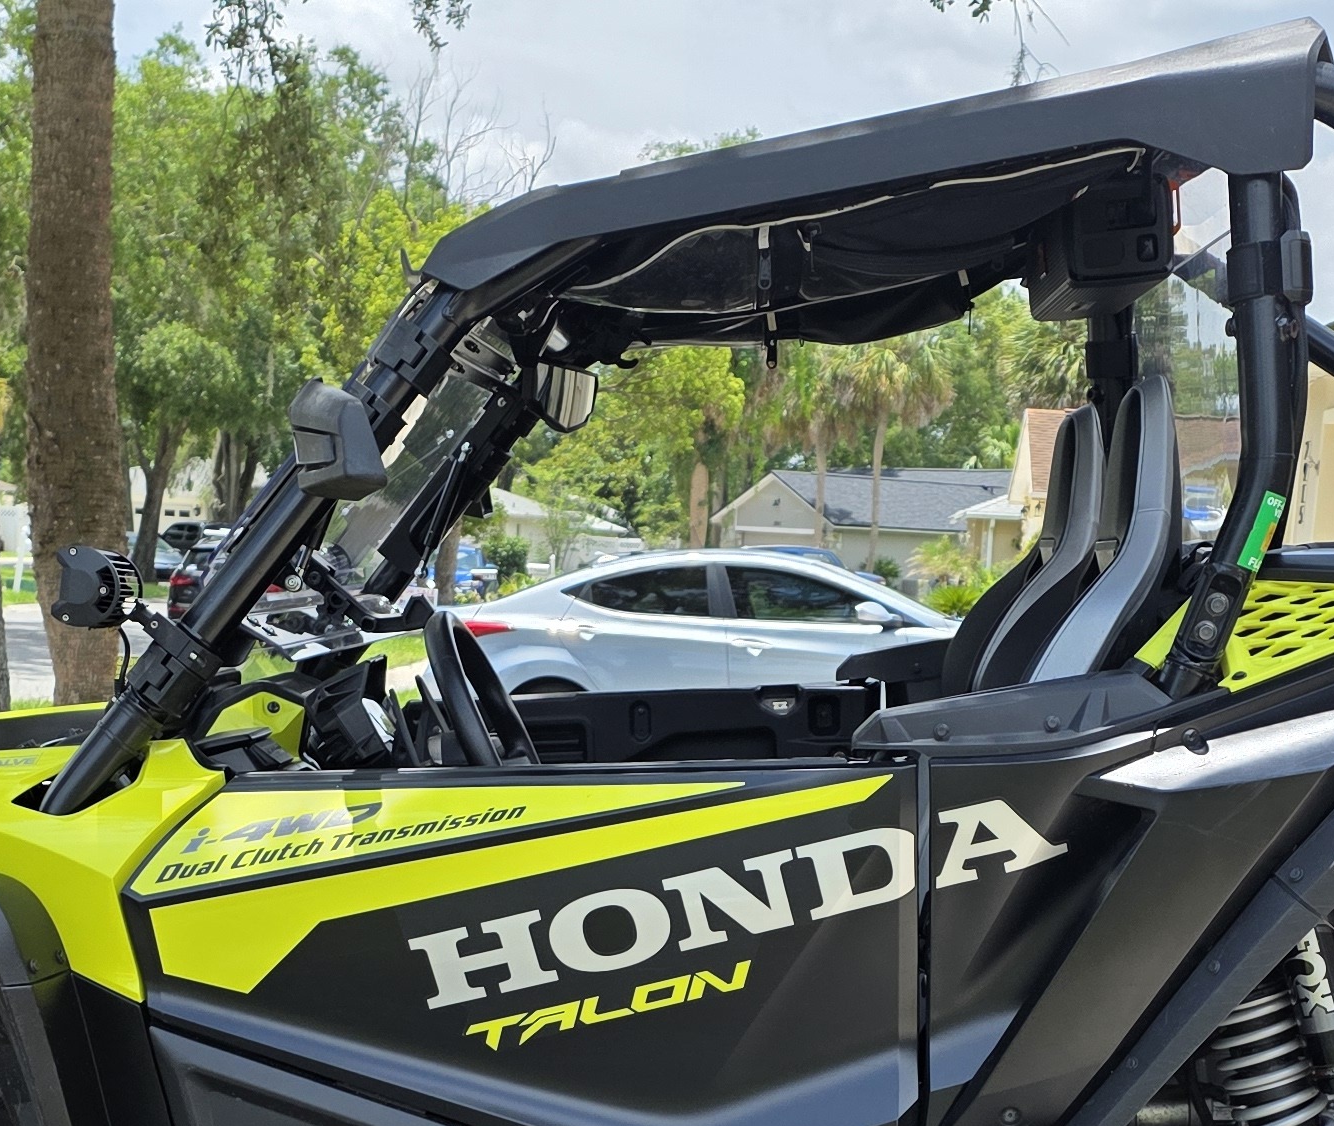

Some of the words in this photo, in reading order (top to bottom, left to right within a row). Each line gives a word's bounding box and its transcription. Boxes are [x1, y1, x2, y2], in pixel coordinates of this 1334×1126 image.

[155, 855, 227, 884] Dual
[230, 841, 322, 870] Clutch
[329, 805, 528, 852] Transmission
[180, 802, 382, 855] i-4WD
[408, 799, 1069, 1009] HONDA
[465, 959, 751, 1051] TALON
